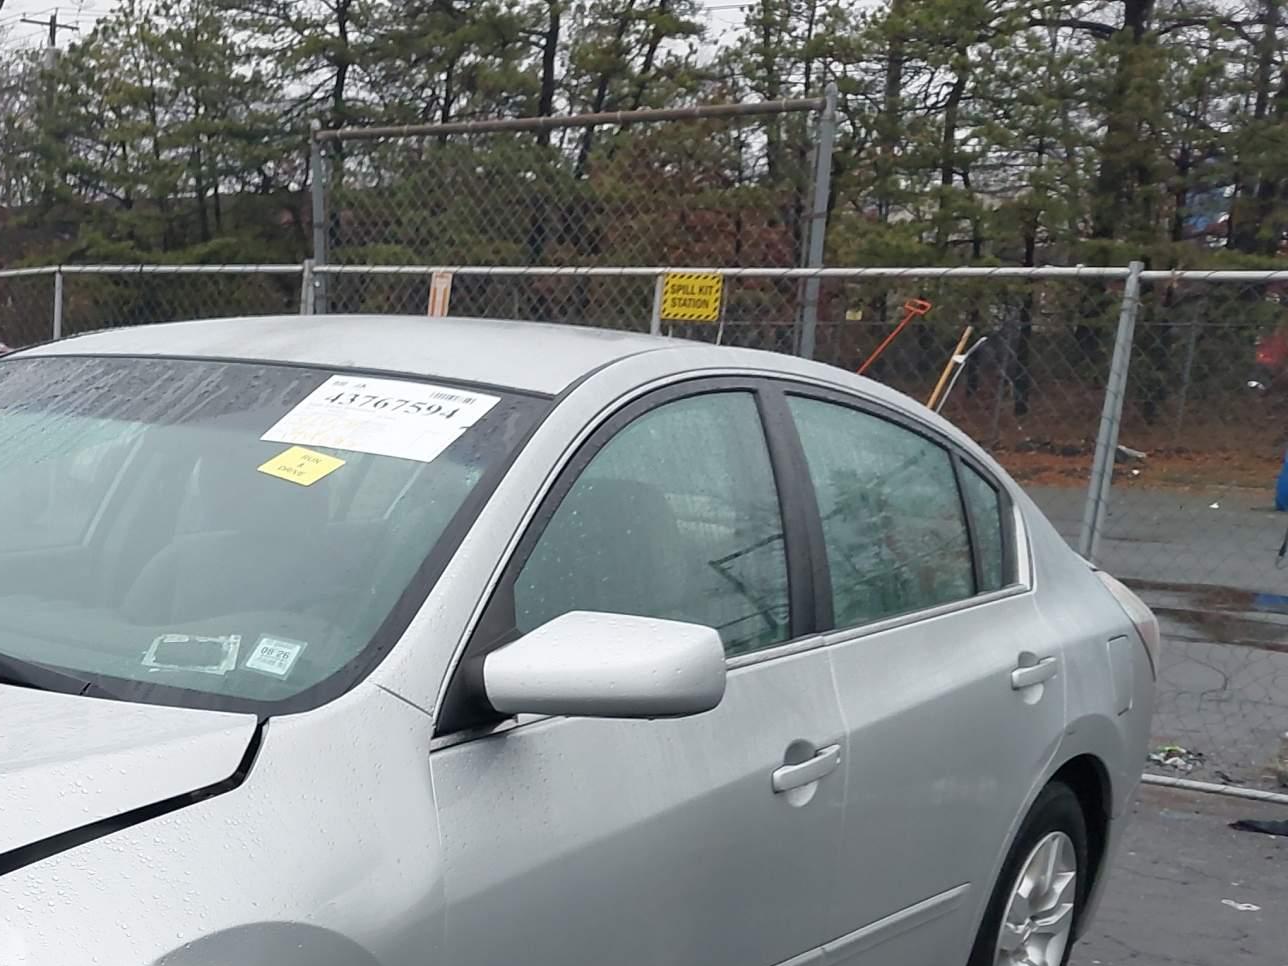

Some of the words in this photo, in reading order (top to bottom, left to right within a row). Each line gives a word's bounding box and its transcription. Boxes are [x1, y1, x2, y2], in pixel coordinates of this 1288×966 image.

[670, 284, 695, 295] SPILL
[698, 285, 714, 296] KIT
[671, 297, 709, 309] STATION
[324, 391, 460, 419] 43767594
